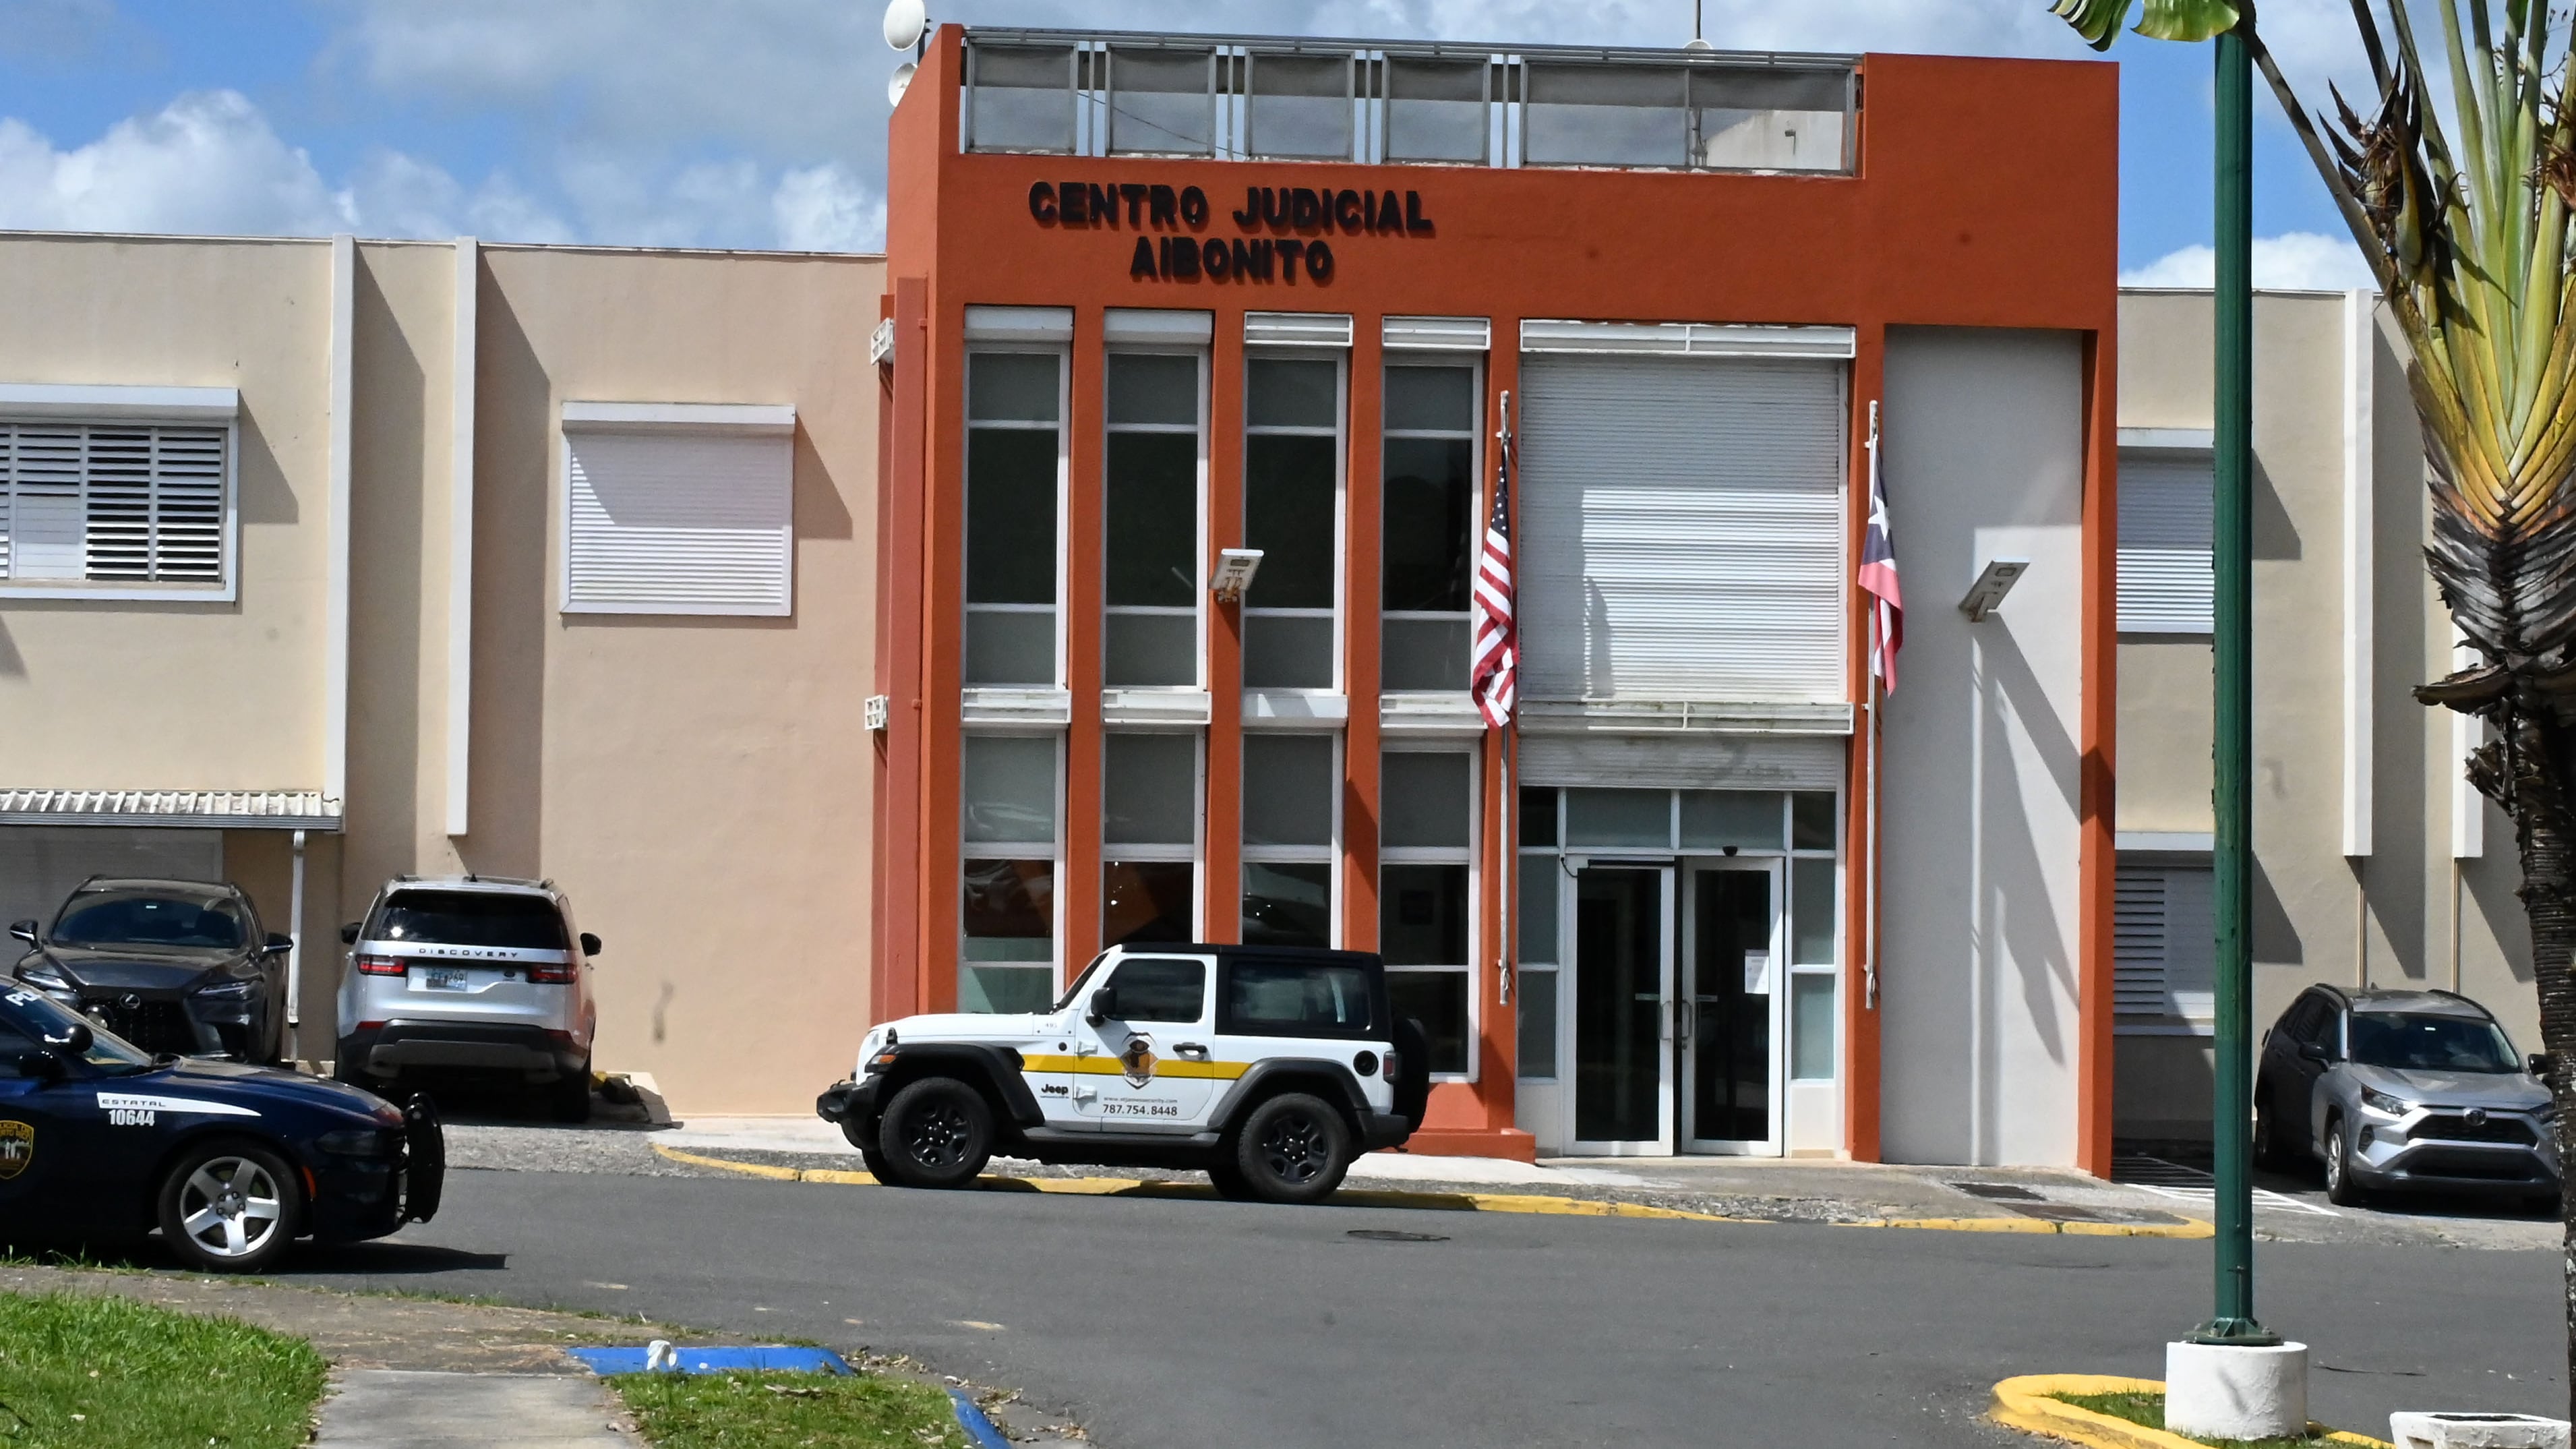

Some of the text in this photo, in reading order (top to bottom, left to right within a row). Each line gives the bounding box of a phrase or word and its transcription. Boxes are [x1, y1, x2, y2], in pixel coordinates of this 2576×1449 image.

[1029, 181, 1435, 237] CENTRO JUDICIAL
[1130, 236, 1334, 285] AIBONITO
[419, 948, 518, 957] DISCOVERY
[1041, 1084, 1069, 1095] Jeep
[102, 1098, 167, 1107] ESTATAL
[1103, 1104, 1178, 1116] 787.754.8448
[109, 1109, 155, 1126] 10644
